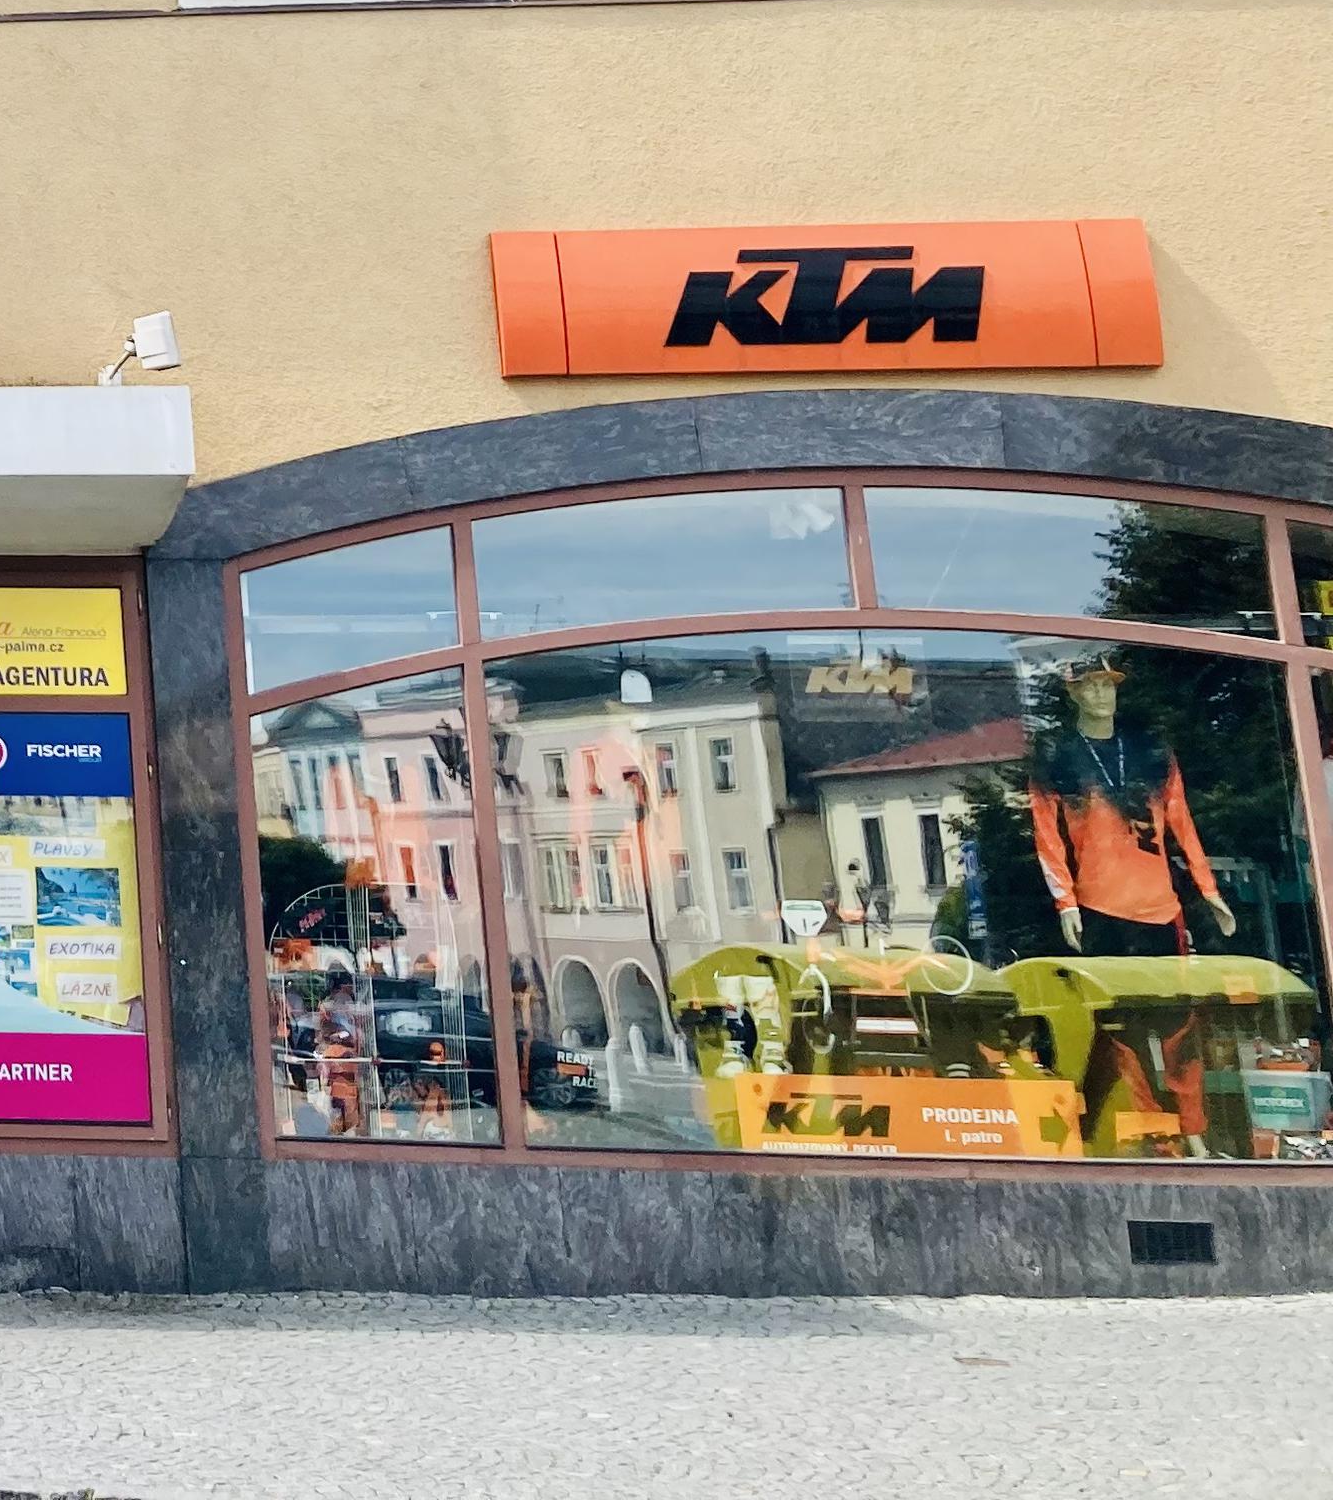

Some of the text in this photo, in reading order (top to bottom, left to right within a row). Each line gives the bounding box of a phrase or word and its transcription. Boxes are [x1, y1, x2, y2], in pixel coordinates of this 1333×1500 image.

[664, 246, 985, 347] KTM
[26, 744, 102, 758] FISCHER
[49, 941, 116, 956] EXOTIKA
[557, 1051, 594, 1066] READY
[761, 1092, 891, 1137] KTM
[922, 1106, 1019, 1125] PRODEJNA
[960, 1130, 1004, 1145] patro
